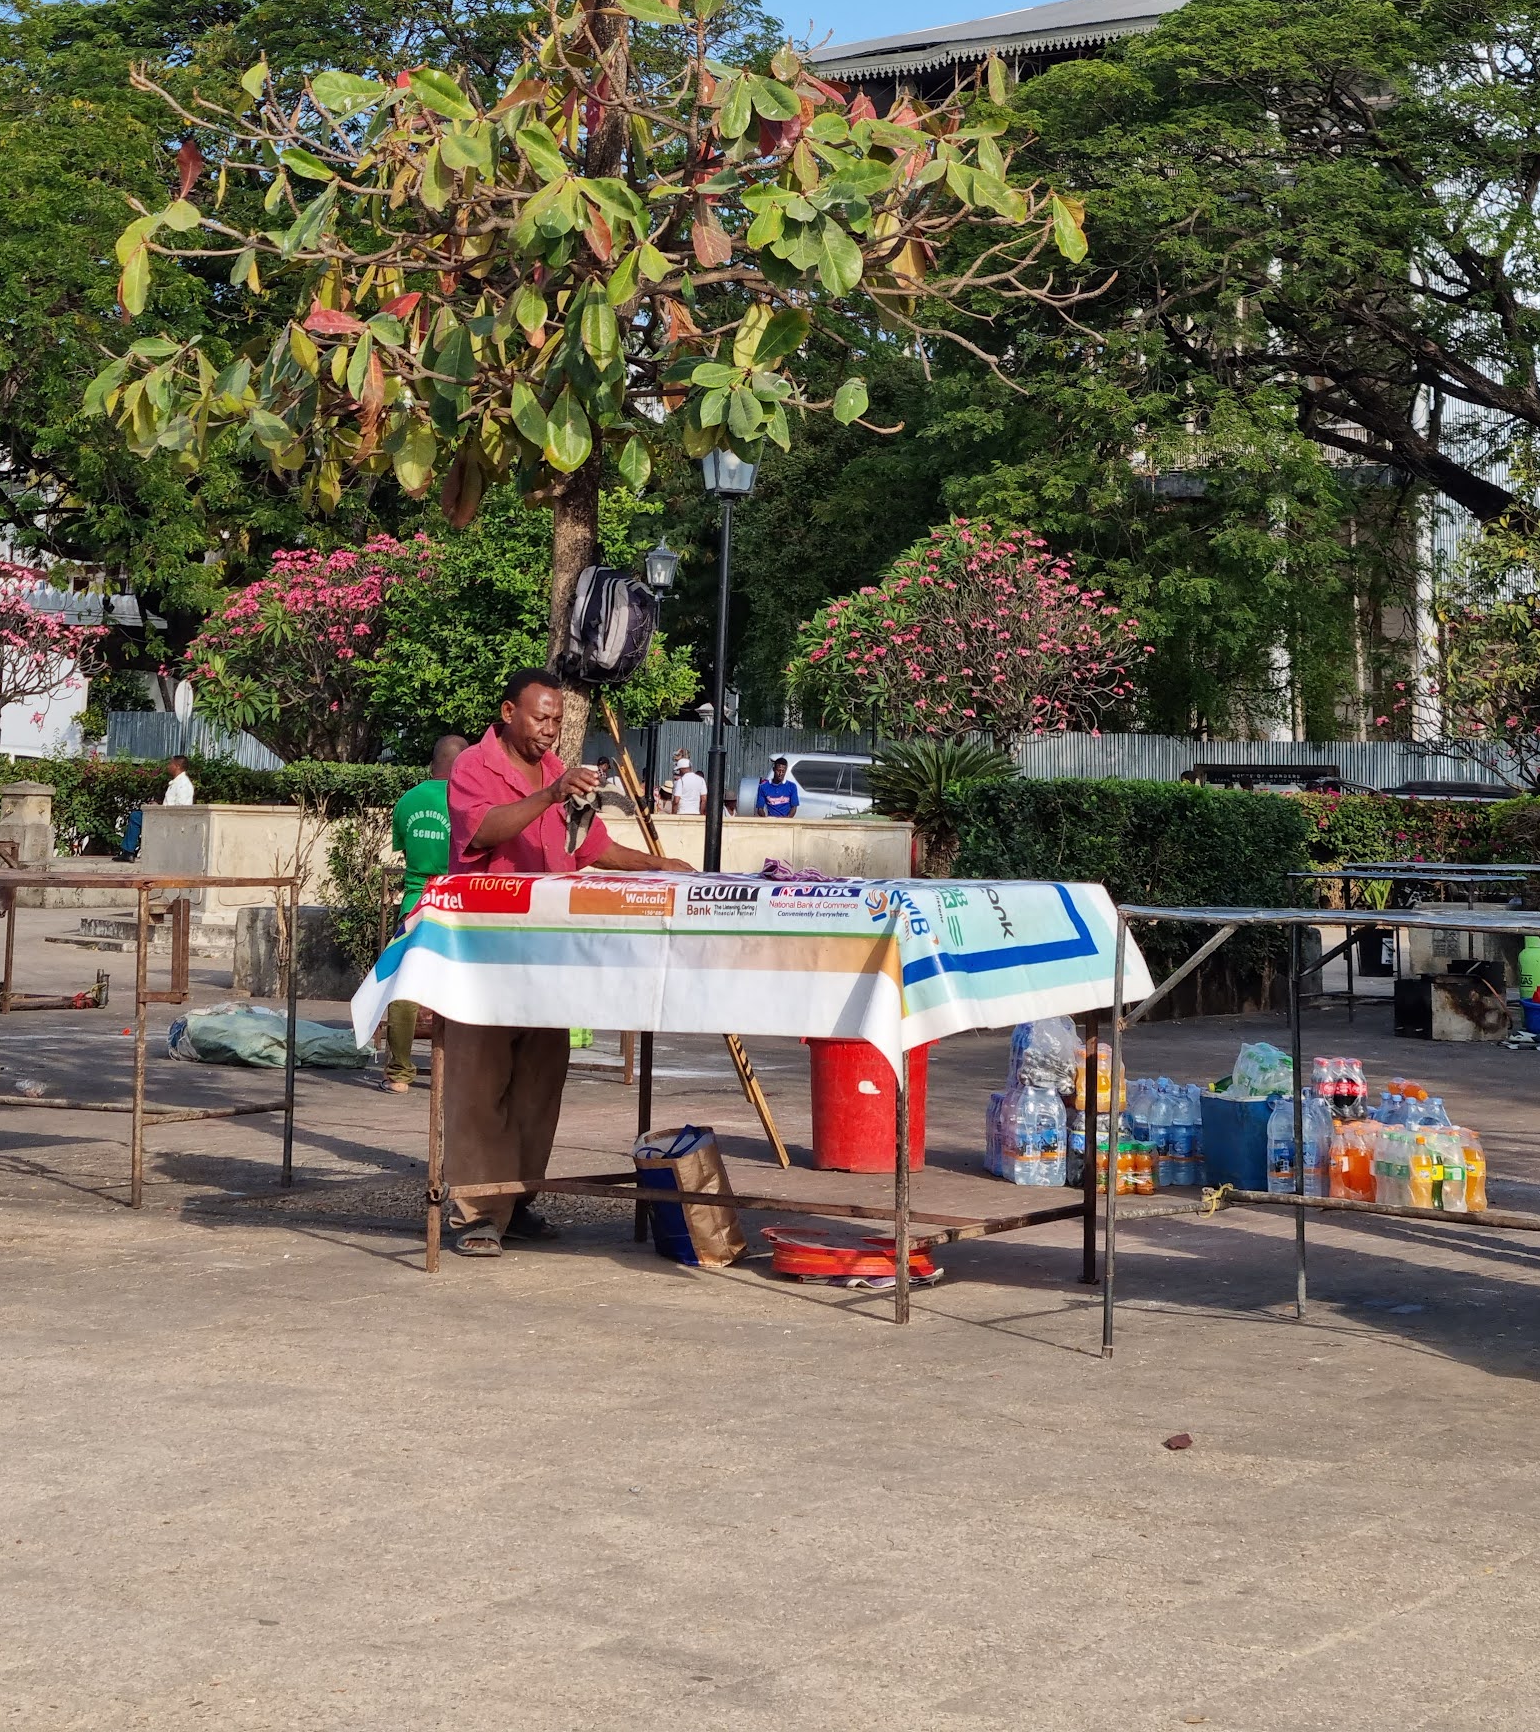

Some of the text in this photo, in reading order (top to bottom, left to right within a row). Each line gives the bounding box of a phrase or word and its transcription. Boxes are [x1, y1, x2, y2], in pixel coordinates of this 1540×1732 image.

[413, 829, 445, 840] SCHOOL
[469, 878, 526, 897] money
[689, 886, 757, 900] EQUITY
[421, 888, 464, 910] airtel
[625, 892, 667, 904] Wakala
[686, 904, 711, 916] Bank
[769, 900, 859, 909] National Bank of Commerce
